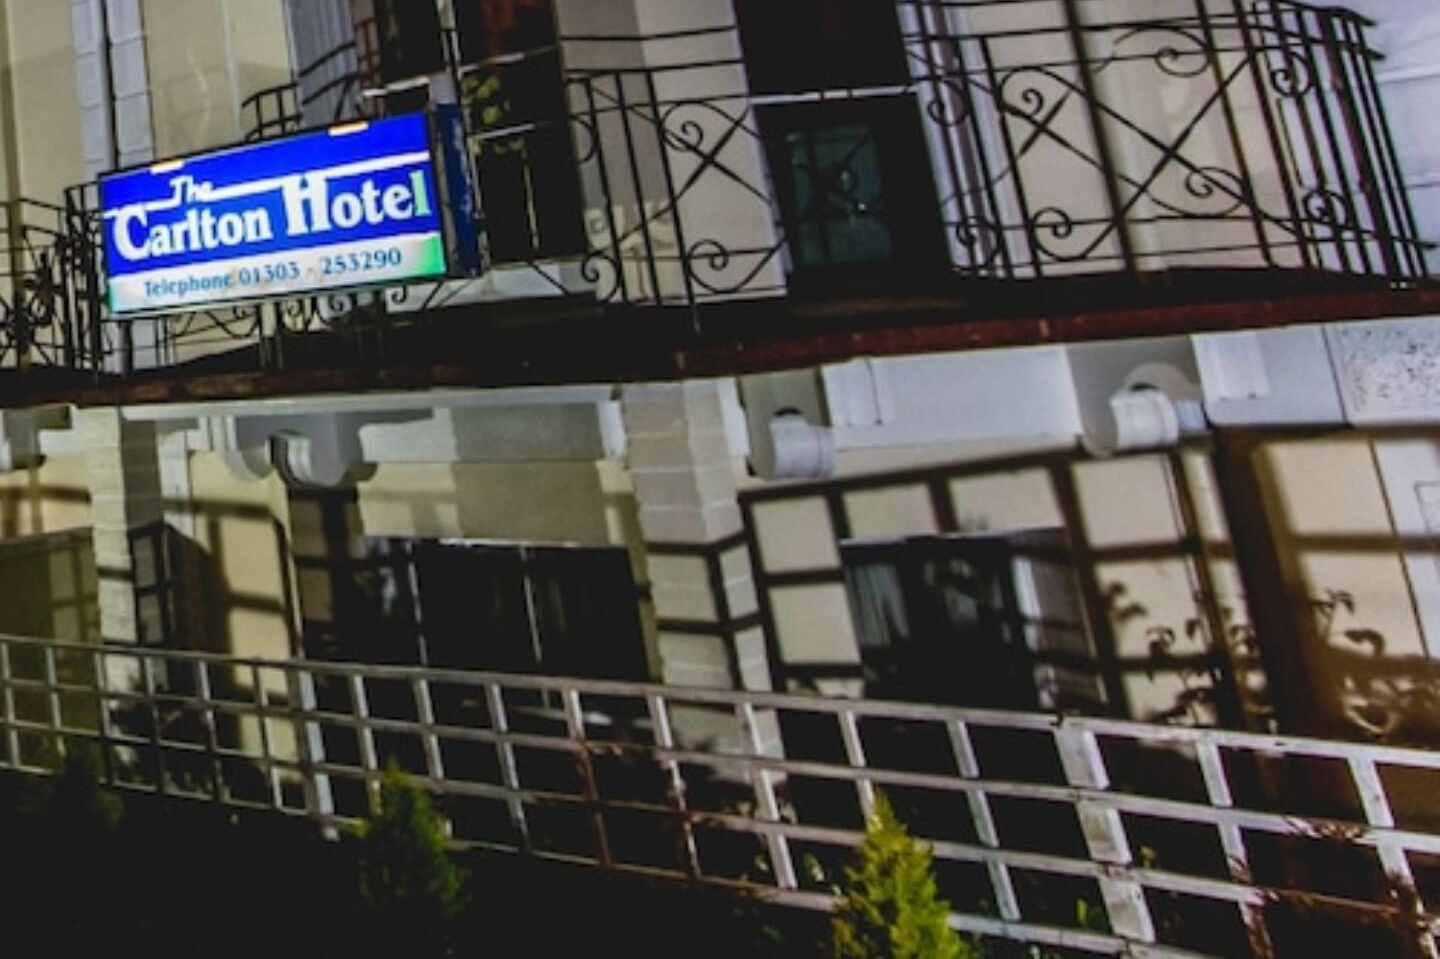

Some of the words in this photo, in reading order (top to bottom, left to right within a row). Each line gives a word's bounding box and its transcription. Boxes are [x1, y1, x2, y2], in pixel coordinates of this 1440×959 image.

[169, 175, 215, 203] The
[113, 204, 272, 261] Carlton
[280, 170, 432, 236] Hotel
[144, 274, 233, 297] Telephone
[238, 262, 300, 285] 01303
[322, 247, 402, 275] 253290
